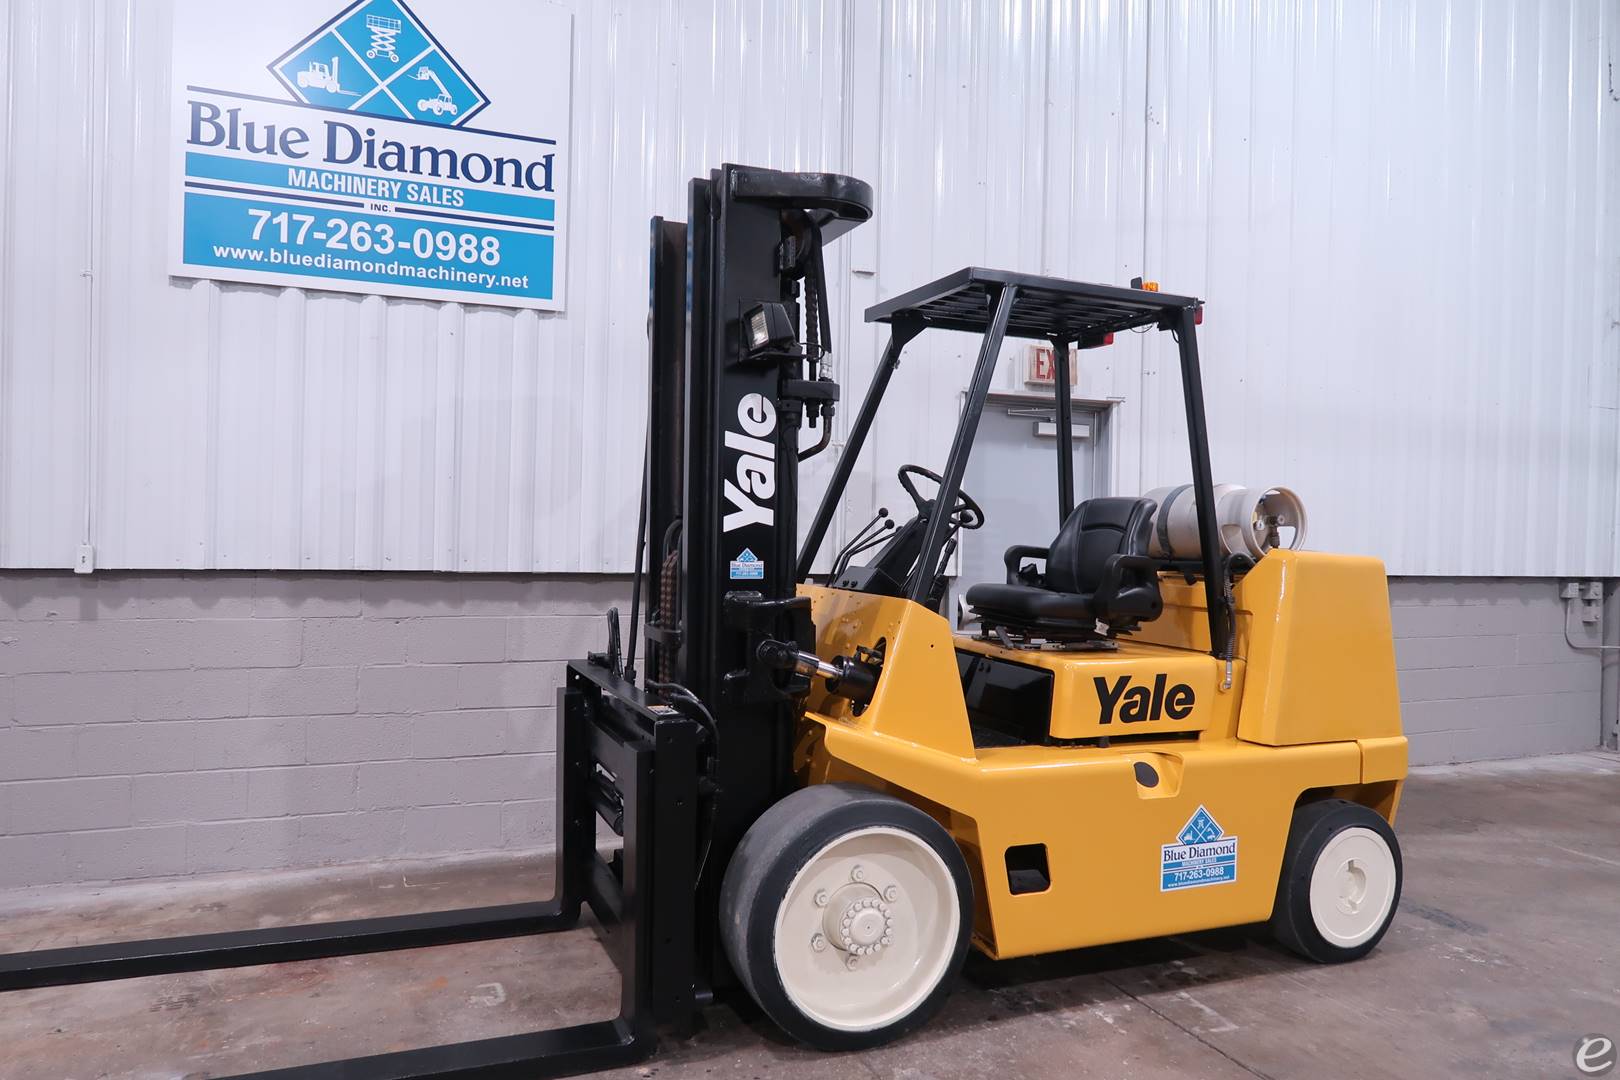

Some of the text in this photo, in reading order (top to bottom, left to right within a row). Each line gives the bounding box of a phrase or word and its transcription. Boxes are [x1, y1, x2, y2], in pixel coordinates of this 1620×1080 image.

[186, 100, 555, 193] Blue Diamond
[288, 168, 464, 208] MACHINERY SALES
[370, 203, 392, 213] INC.
[248, 208, 501, 266] 717-263-0988
[213, 245, 529, 289] www.bluediamondmachinery.net
[723, 392, 777, 533] Yale
[1093, 673, 1196, 725] Yale
[1163, 850, 1186, 862] Blue
[1189, 842, 1235, 859] Diamond
[1174, 866, 1224, 882] 717-263-0988
